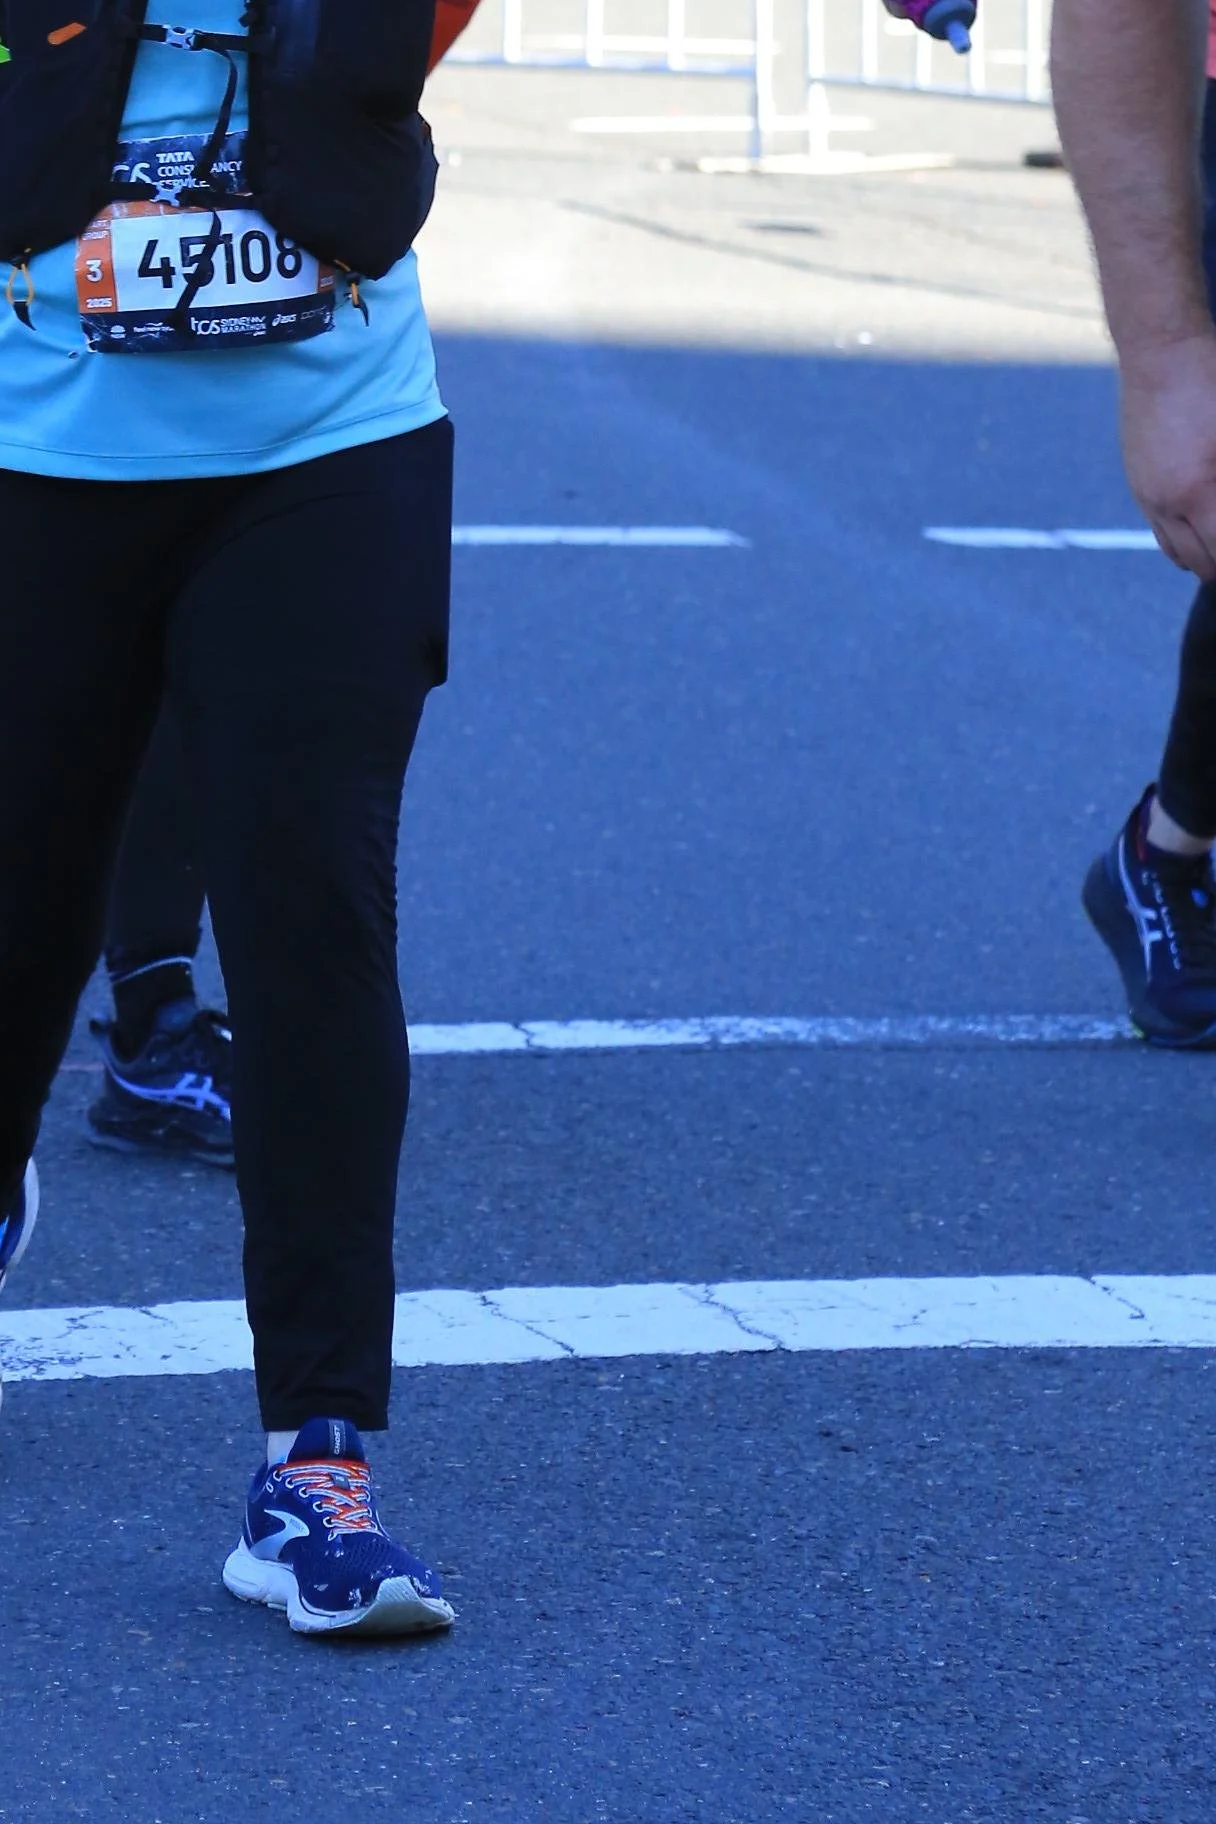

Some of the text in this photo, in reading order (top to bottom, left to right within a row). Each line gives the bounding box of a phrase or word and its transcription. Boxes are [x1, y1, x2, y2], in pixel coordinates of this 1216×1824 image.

[156, 151, 195, 163] TATA
[157, 160, 243, 177] CONSANCY
[137, 230, 303, 289] 45108
[86, 259, 103, 282] 3
